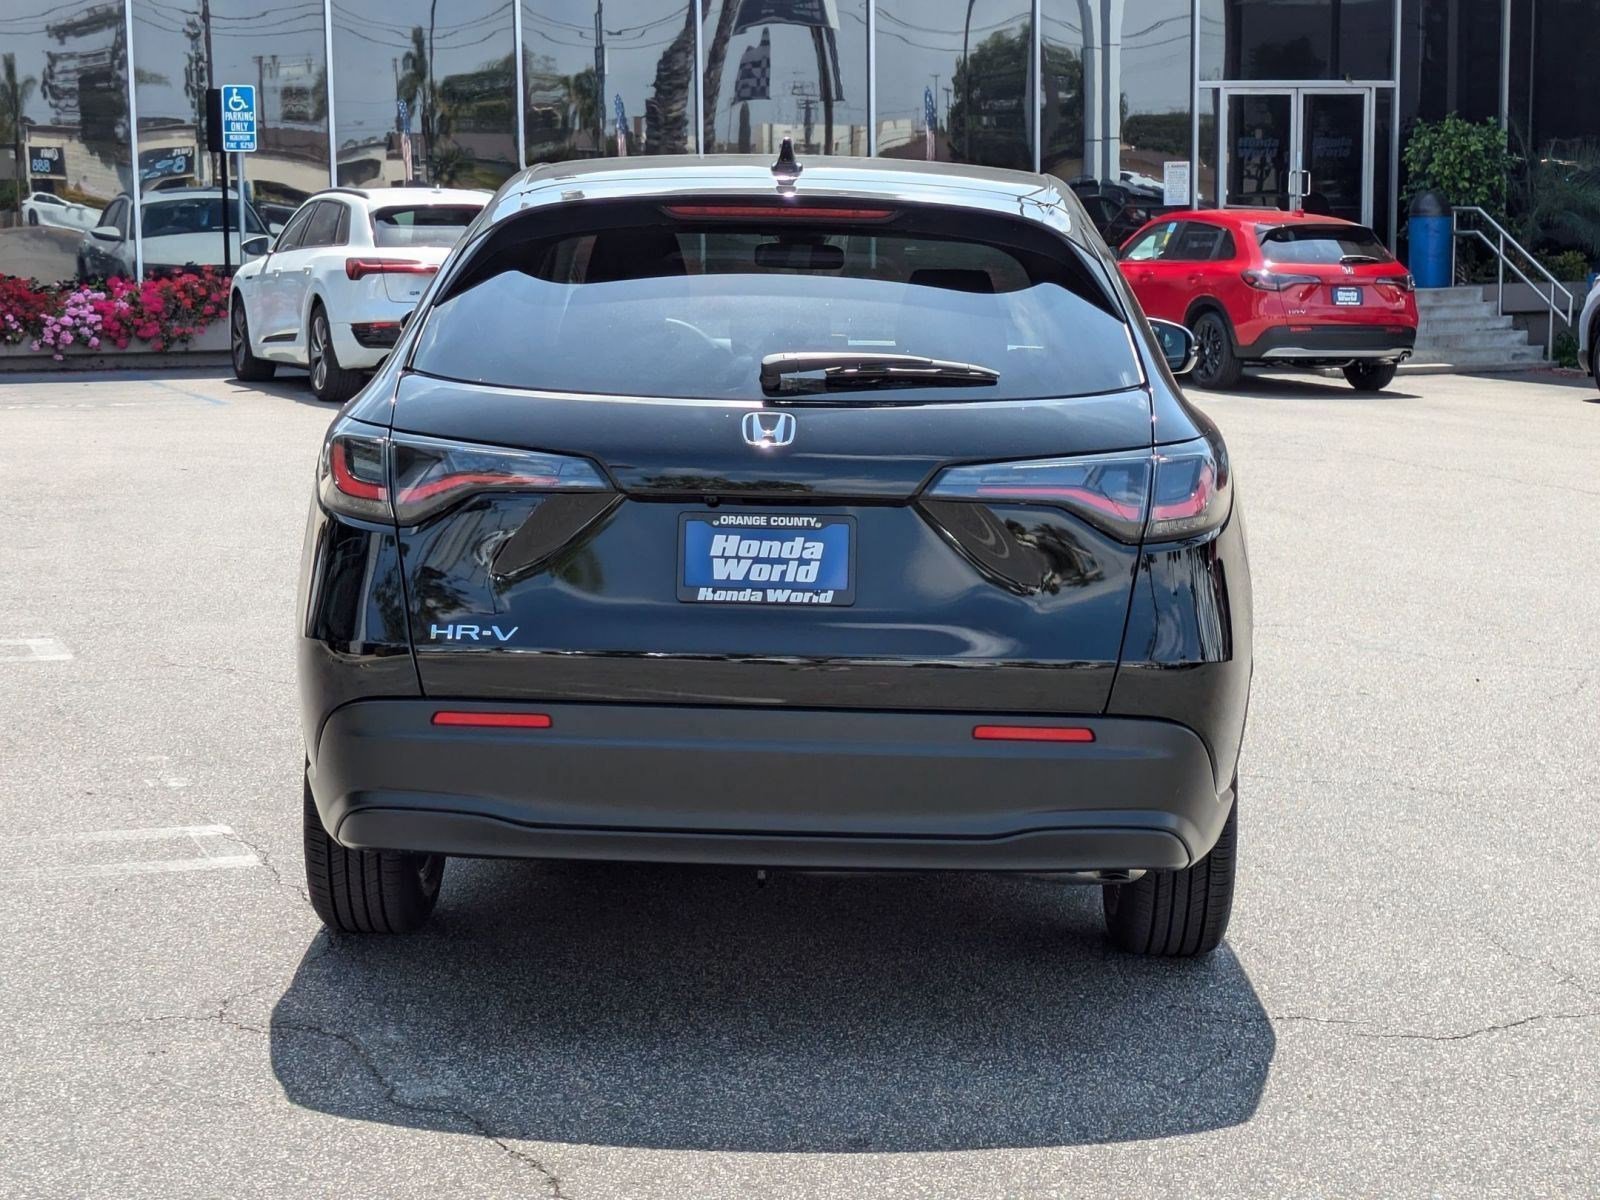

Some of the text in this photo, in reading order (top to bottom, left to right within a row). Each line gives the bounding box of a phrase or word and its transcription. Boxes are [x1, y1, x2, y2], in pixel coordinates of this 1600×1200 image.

[225, 111, 254, 121] PARKING
[231, 122, 248, 131] ONLY
[720, 515, 817, 527] ORANGE COUNTY
[710, 534, 825, 560] Honda
[712, 557, 821, 583] World
[430, 624, 519, 641] HR-V
